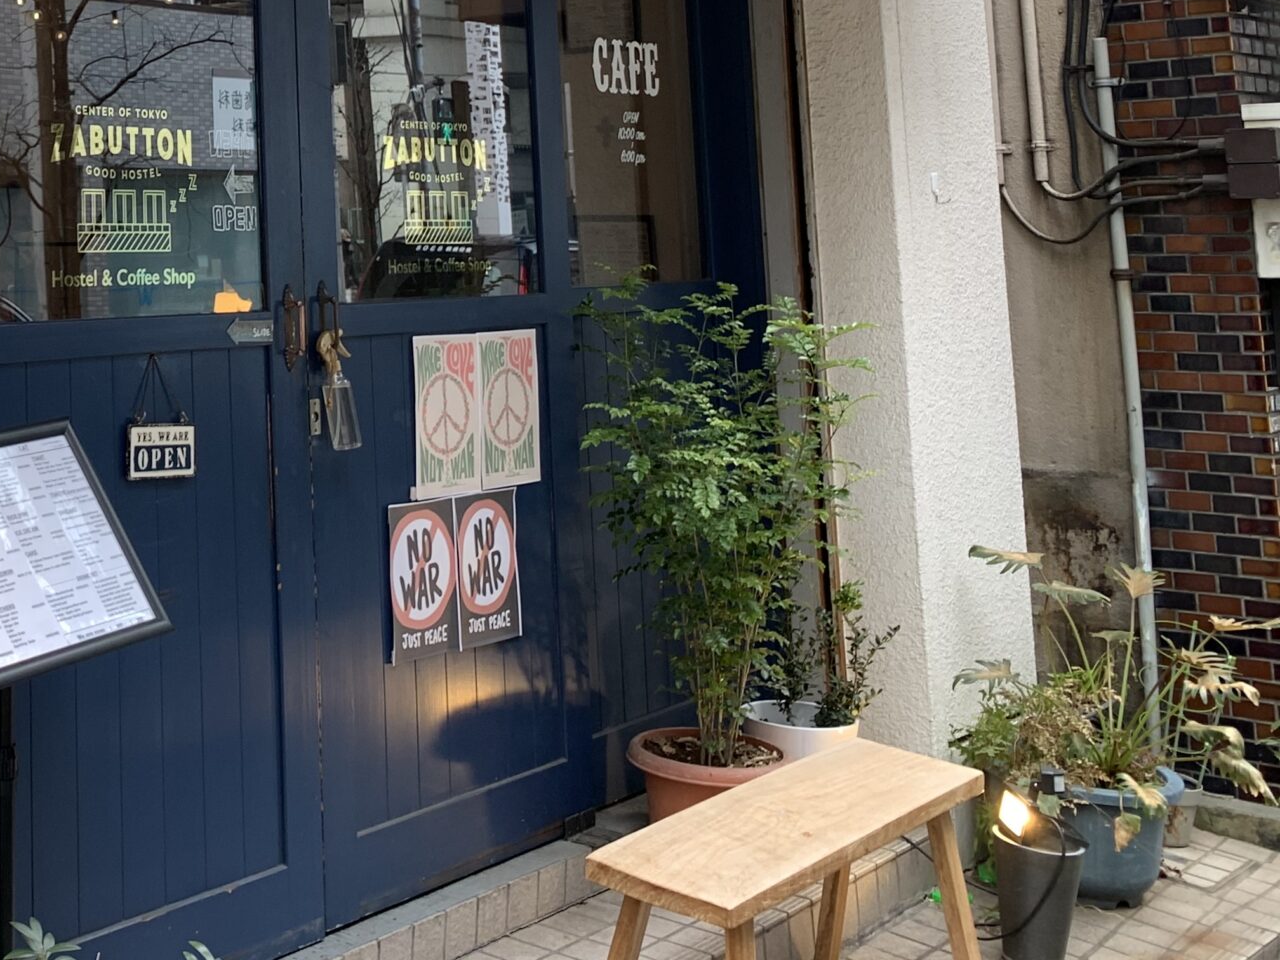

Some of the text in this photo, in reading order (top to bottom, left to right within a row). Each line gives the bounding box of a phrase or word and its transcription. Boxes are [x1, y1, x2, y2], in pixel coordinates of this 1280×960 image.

[592, 37, 660, 97] CAFE
[75, 104, 168, 120] CENTER OF TOKYO
[399, 119, 429, 131] CENTER
[622, 111, 640, 124] OPEN
[50, 123, 193, 167] ZABUTTON
[383, 135, 487, 172] ZABUTTON
[85, 165, 162, 181] GOOD HOSTEL
[409, 171, 464, 184] GOOD HOSTEL
[212, 205, 257, 232] OPEN
[51, 268, 196, 289] Hostel & Coffee Shop
[388, 259, 421, 274] Hostel
[434, 257, 465, 273] Coffee
[445, 341, 475, 400] LOVE
[507, 337, 533, 390] LOVE
[159, 432, 173, 442] WE
[173, 430, 190, 441] ARE
[484, 425, 535, 474] NOT WAR
[137, 446, 187, 471] OPEN
[420, 433, 475, 483] NOT WAR
[406, 528, 433, 563] NO
[473, 517, 495, 553] NO
[399, 562, 442, 611] WAR
[468, 552, 505, 598] WAR
[468, 609, 511, 634] JUST PEACE
[402, 624, 448, 650] JUST PEACE
